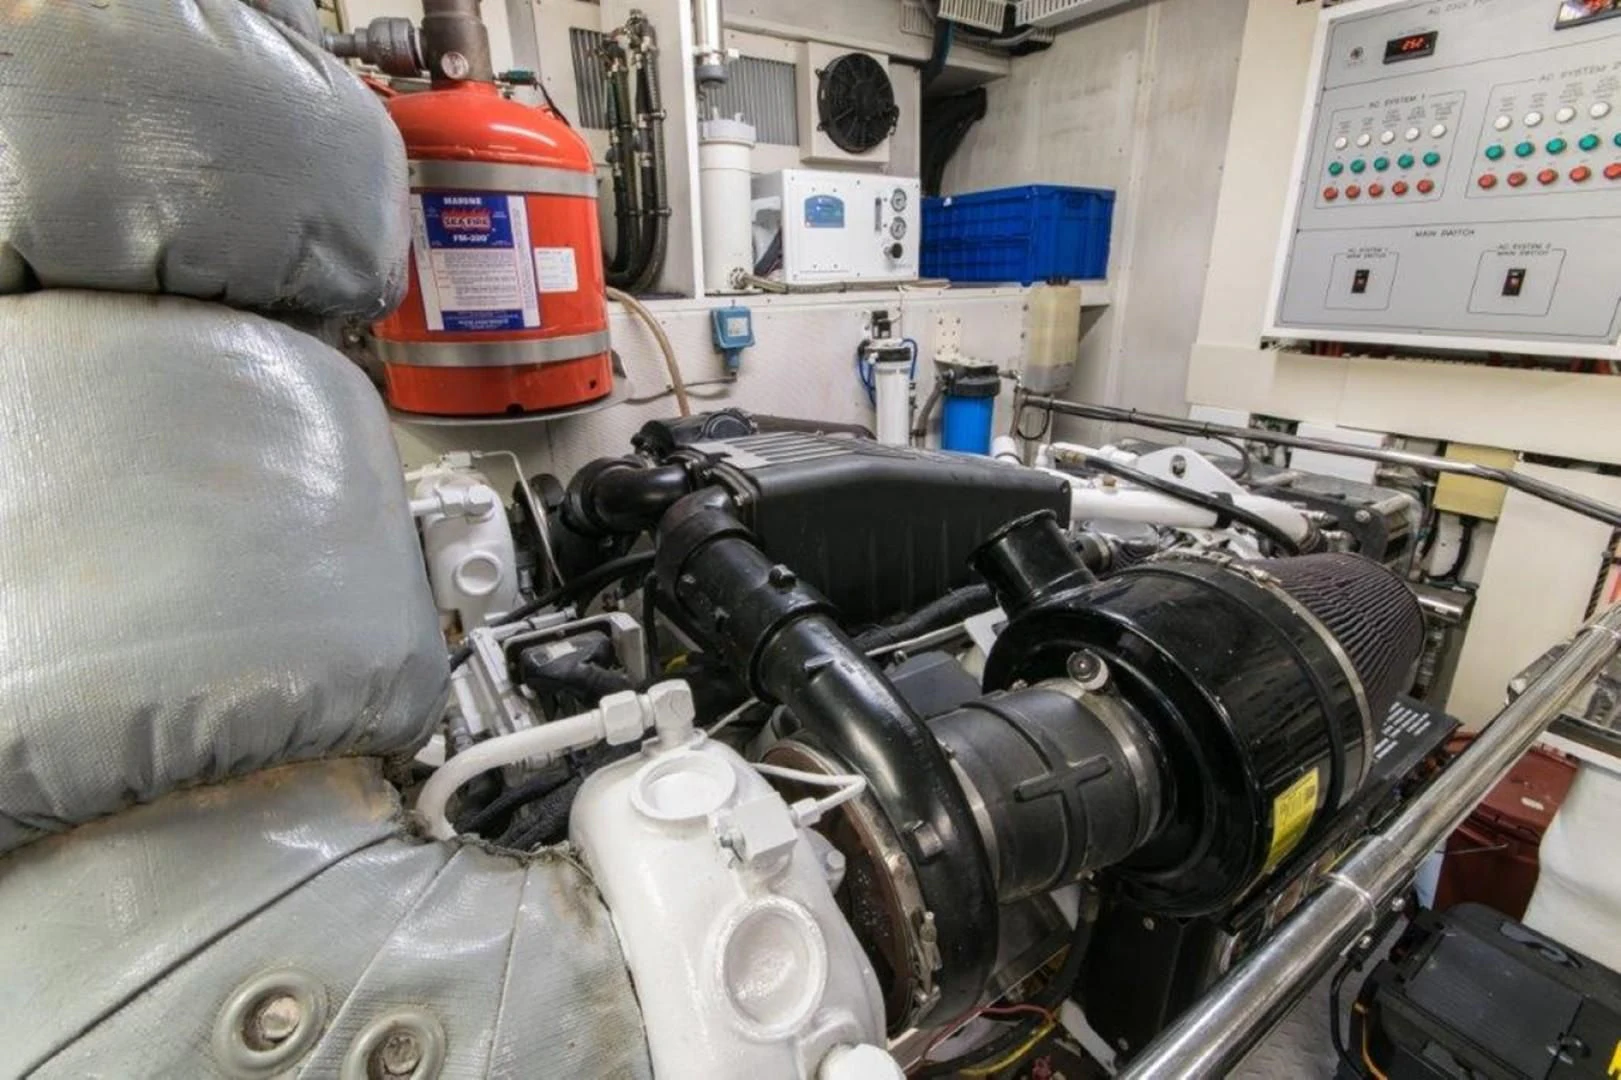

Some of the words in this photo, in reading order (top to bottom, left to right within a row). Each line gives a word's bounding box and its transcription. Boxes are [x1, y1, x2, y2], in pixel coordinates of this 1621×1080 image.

[1538, 71, 1555, 82] AC
[1560, 64, 1606, 79] SYSTEM
[1369, 99, 1381, 109] AC
[1384, 95, 1416, 106] SYSTEM
[445, 216, 465, 227] SEA
[466, 216, 488, 227] FIRE
[1415, 230, 1438, 239] MAIN
[1441, 228, 1476, 238] SWITCH
